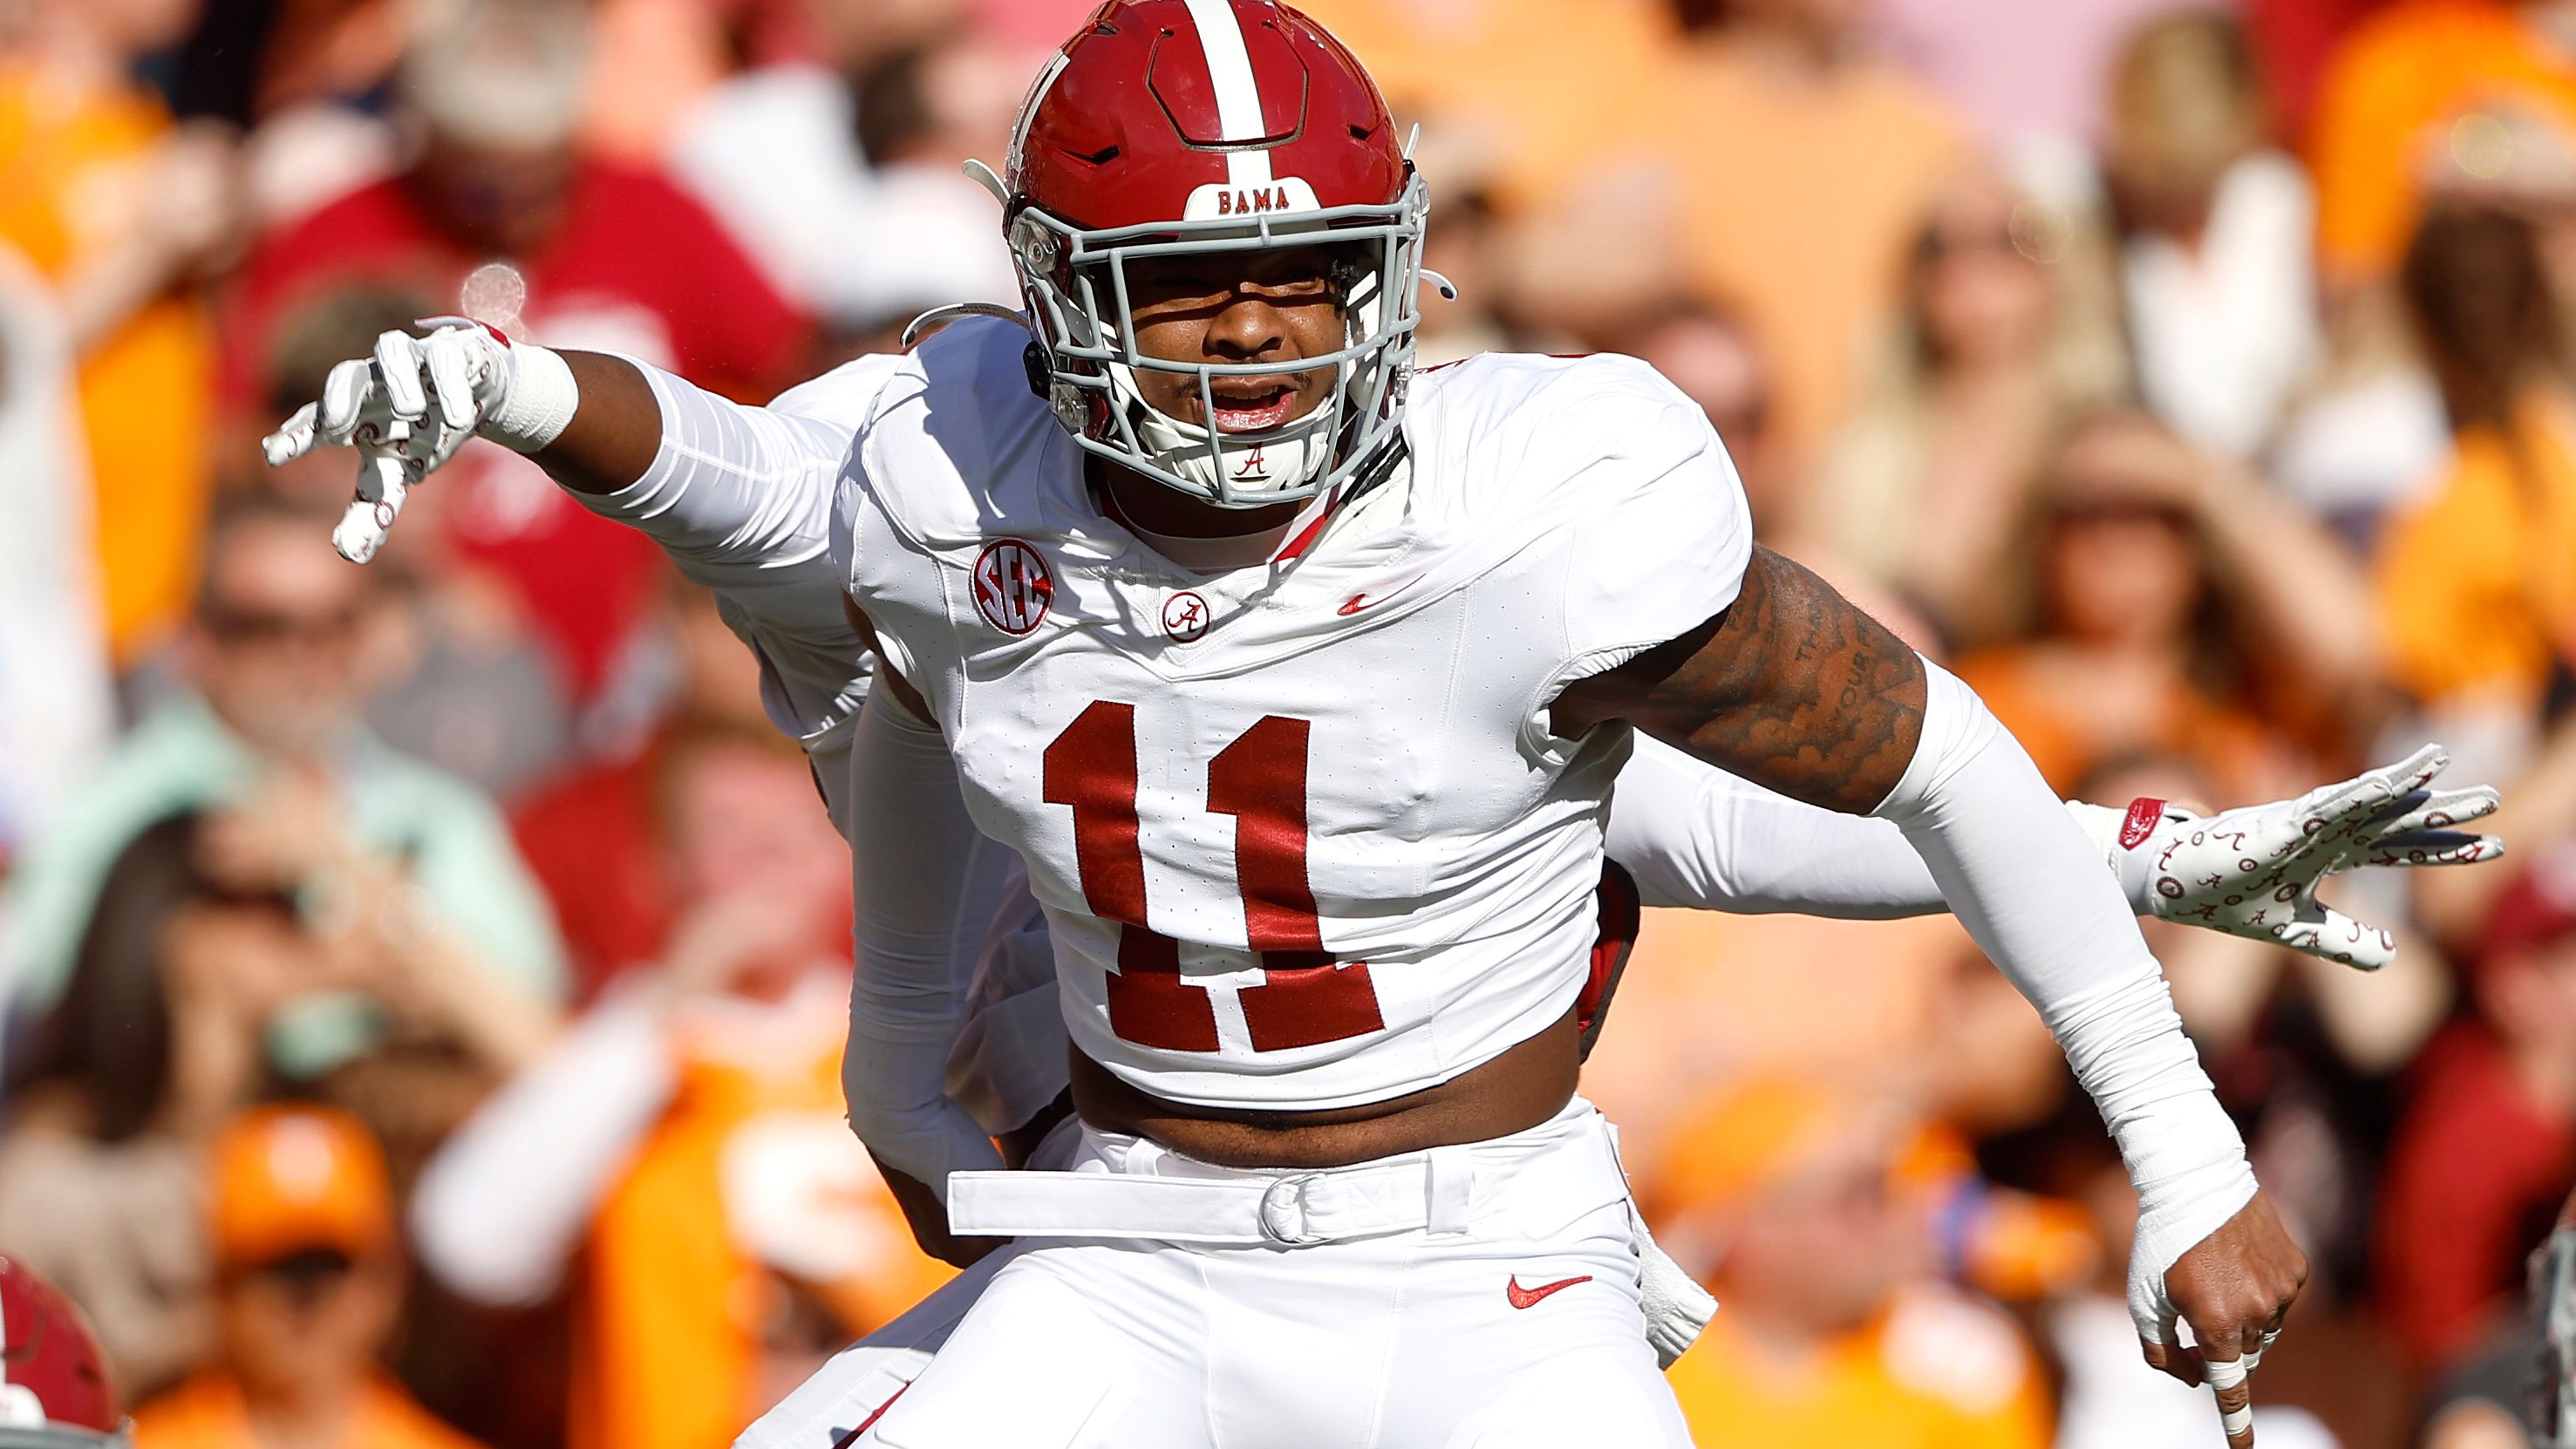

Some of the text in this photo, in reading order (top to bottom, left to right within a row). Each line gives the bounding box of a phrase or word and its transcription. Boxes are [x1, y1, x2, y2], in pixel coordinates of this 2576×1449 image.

[1218, 187, 1290, 214] BAMA
[1234, 441, 1267, 476] A
[978, 546, 1046, 630] SEC
[1168, 600, 1202, 632] A
[1042, 699, 1387, 1052] 11
